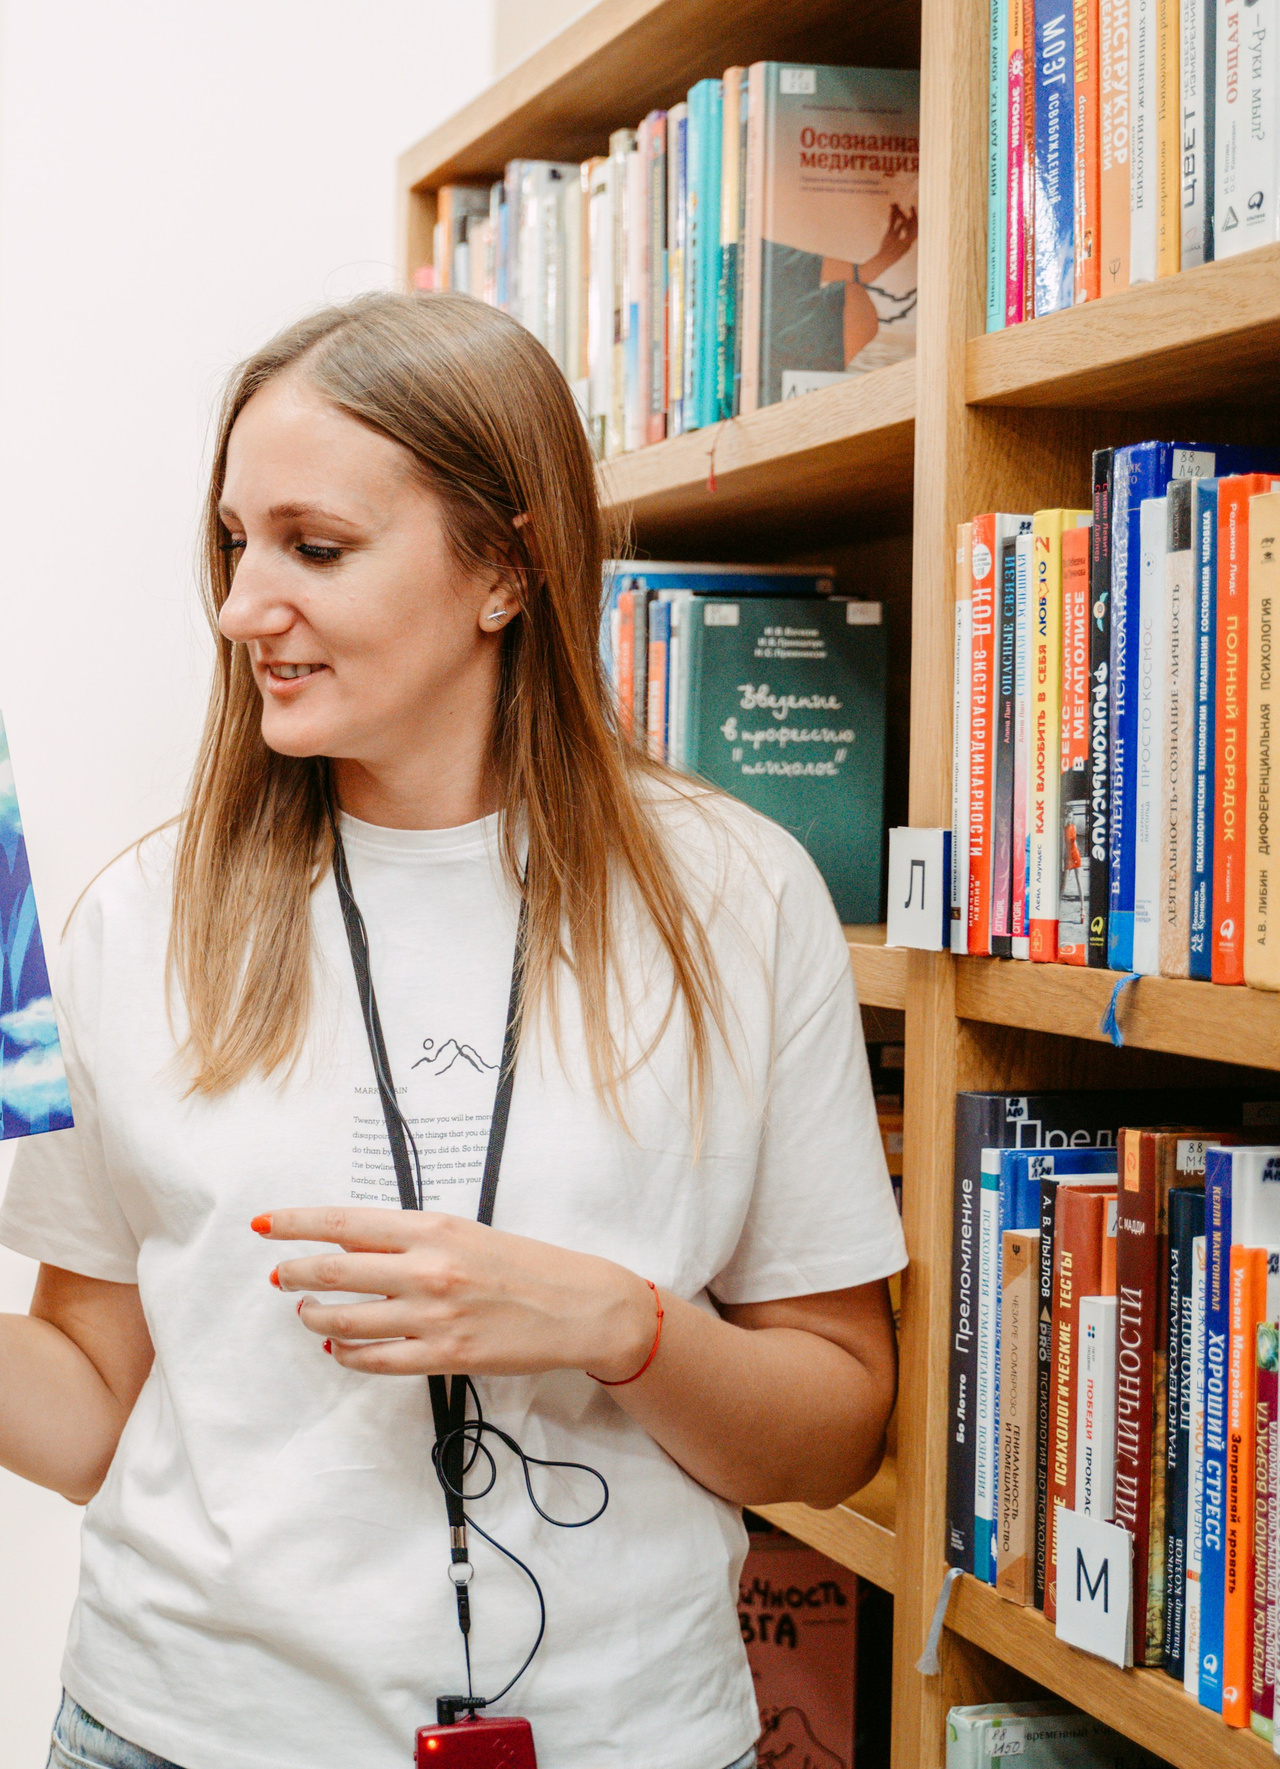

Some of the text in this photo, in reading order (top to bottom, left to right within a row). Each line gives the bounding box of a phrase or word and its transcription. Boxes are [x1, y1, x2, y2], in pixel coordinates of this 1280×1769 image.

[1042, 13, 1066, 86] МОЗГ
[1113, 0, 1128, 164] ОНСТРУКТОР
[1226, 11, 1240, 105] ОБЩАЯ
[1248, 28, 1266, 80] Руки
[800, 127, 919, 154] Осознанна
[1011, 85, 1021, 149] ЭГОИЗМ
[1102, 100, 1112, 171] ЖИЗНИ
[1137, 114, 1145, 210] ПСИХОЛОГИЯ
[1183, 106, 1197, 210] ЦВЕТ
[1181, 451, 1195, 462] 88
[1229, 503, 1238, 596] Реджина Лидс
[972, 587, 992, 638] КОД
[1002, 555, 1016, 696] ОПАСНЫЕ СВЯЗИ
[1115, 539, 1128, 716] ПСИХОАНАЛИЗ
[1035, 536, 1051, 834] КАК ВЛЮБИТЬ В СЕБЯ 2
[1073, 590, 1086, 740] МЕГАПОЛИСЕ
[1141, 618, 1153, 787] ПРОСТО КОСМОС
[1196, 510, 1212, 873] ПСИХОЛОГИЧЕСКИЕ ТЕХНОЛОГИИ УПРАВЛЕНИЯ СОСТОЯНИЕМ ЧЕЛОВЕКА
[720, 717, 856, 750] в профессию
[969, 650, 987, 857] ЭКСТРАОРДИНАРНОСТИ
[1073, 755, 1085, 772] В
[1168, 583, 1180, 927] ДЕЯТЕЛЬНОСТЬ СОЗНАНИЕ ЛИЧНОСТЬ
[1222, 616, 1239, 841] ПОЛНЫЙ ПОРЯДОК
[1258, 597, 1272, 915] ЛИБИН ДИФФЕРЕНЦИАЛЬНАЯ ПСИХОЛОГИЯ
[1111, 738, 1124, 894] В. М. ЛЕЙБИН
[904, 859, 926, 910] Л
[973, 880, 981, 921] ВИШЕН
[1012, 899, 1022, 934] CITYGIRL
[1191, 890, 1199, 931] Леонова
[1198, 881, 1206, 930] Кузнецова
[353, 1116, 381, 1126] Twenty
[436, 1116, 450, 1126] you
[451, 1114, 464, 1122] will
[354, 1086, 380, 1095] MARK
[425, 1130, 478, 1141] things that you
[351, 1160, 482, 1170] the from the safe
[363, 1147, 381, 1155] than
[424, 1148, 437, 1158] you
[462, 1145, 472, 1153] So
[436, 1176, 482, 1185] winds your
[1188, 1142, 1203, 1153] 88
[1041, 1195, 1052, 1298] А. В. ЛЫЗЛОВ
[1124, 1219, 1146, 1236] МАДДИ
[1211, 1185, 1222, 1311] КЕЛЛИ МАКГОНИГАЛ
[956, 1178, 973, 1445] Бо Лотто Преломление
[1059, 1250, 1073, 1309] ТЕСТЫ
[977, 1209, 991, 1499] ПСИХОЛОГИЯ ГУМАНИТАРНОГО ПОЗНАНИЯ
[1009, 1295, 1019, 1417] ЧЕЗАРЕ ЛОМБРОЗО
[1038, 1323, 1047, 1362] PRO
[1117, 1285, 1142, 1466] ЛИЧНОСТИ
[1167, 1249, 1179, 1468] ТРАНСПЕРСОНАЛЬНАЯ
[1180, 1296, 1193, 1430] ПСИХОЛОГИЯ
[1054, 1320, 1071, 1486] ПСИХОЛОГИЧЕСКИЕ
[1085, 1378, 1094, 1441] ПОБЕДИ
[1205, 1329, 1225, 1551] ХОРОШИЙ СТРЕСС
[1228, 1267, 1244, 1594] Уильям Макрейвен Заправляй кровать
[1003, 1435, 1012, 1552] ПОМЕШАТЕЛЬСТВО
[1011, 1424, 1020, 1521] ГЕНИАЛЬНОСТЬ
[1036, 1371, 1048, 1590] ПСИХОЛОГИЯ ДО ПСИХОЛОГИИ
[1193, 1381, 1205, 1562] ПОЧЕМУ ТЫ ПОКА НЕ
[1268, 1421, 1278, 1494] ПСИХОЛОГА
[1076, 1547, 1109, 1613] М
[1252, 1401, 1269, 1694] КРИЗИСЫ ПОЖИЛОГО ВОЗРАСТА
[1267, 1497, 1276, 1600] ПРАКТИЧЕСКОГО
[1172, 1538, 1184, 1659] Владимир КОЗЛОВ
[1189, 1605, 1198, 1654] ТРЕЙСИ
[1265, 1604, 1275, 1686] СПРАВОЧНИК
[991, 1728, 1007, 1741] 88
